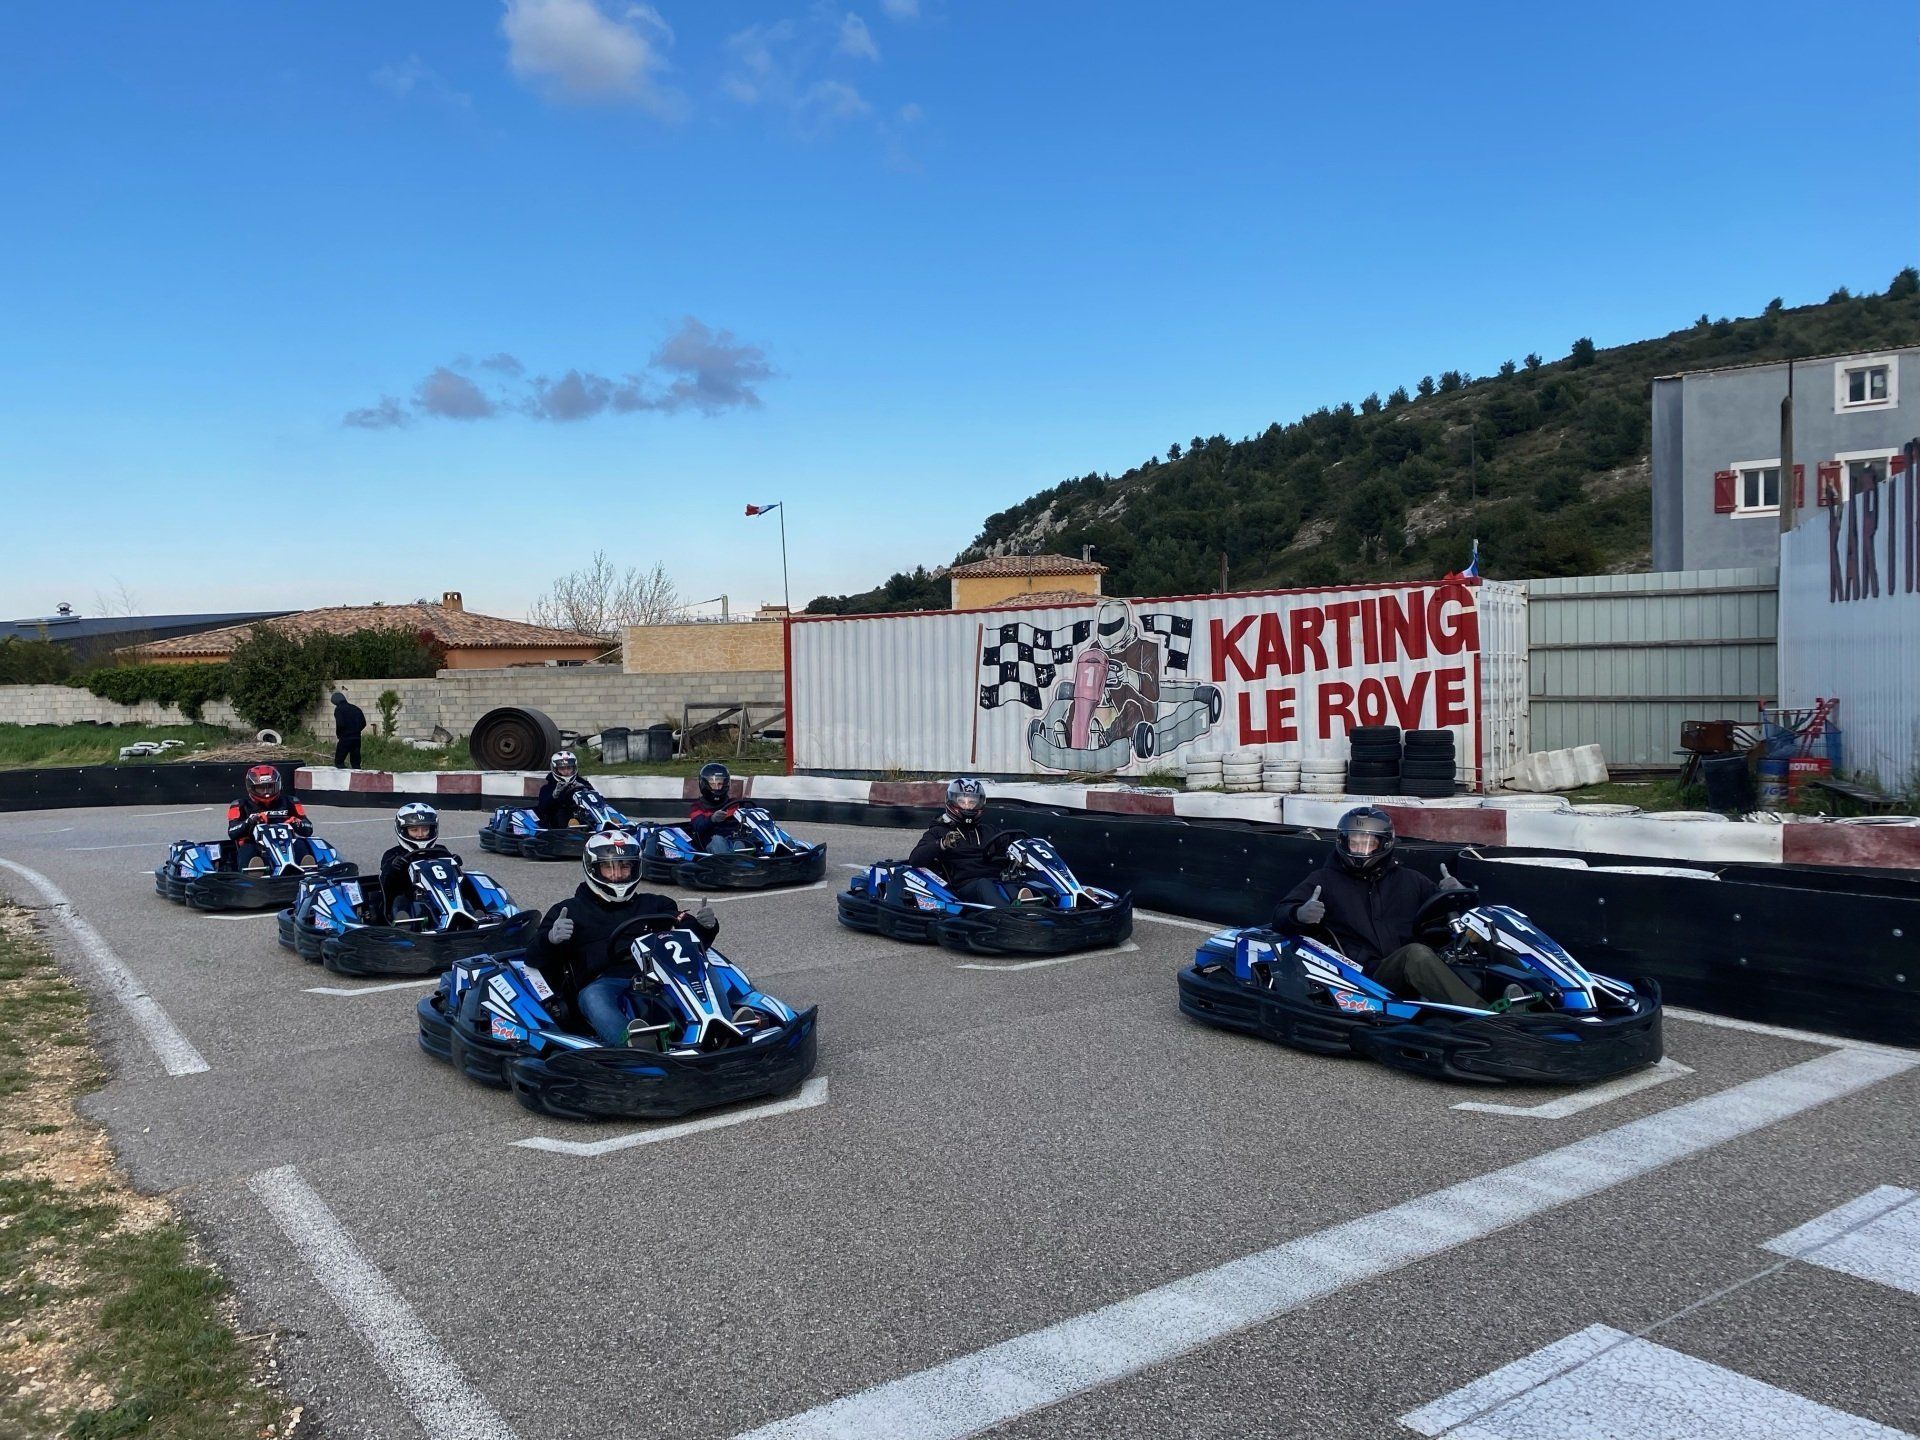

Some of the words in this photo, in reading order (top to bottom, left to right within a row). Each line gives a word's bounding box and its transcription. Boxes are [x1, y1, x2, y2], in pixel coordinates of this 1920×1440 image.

[1210, 584, 1480, 682] KARTING
[1083, 666, 1095, 687] 1
[1238, 687, 1298, 746] LE
[1318, 667, 1469, 739] ROVE
[750, 811, 770, 820] 10
[268, 828, 289, 840] 13
[1032, 844, 1053, 859] 5
[431, 865, 448, 880] 6
[1504, 914, 1537, 935] 4
[664, 940, 692, 965] 2
